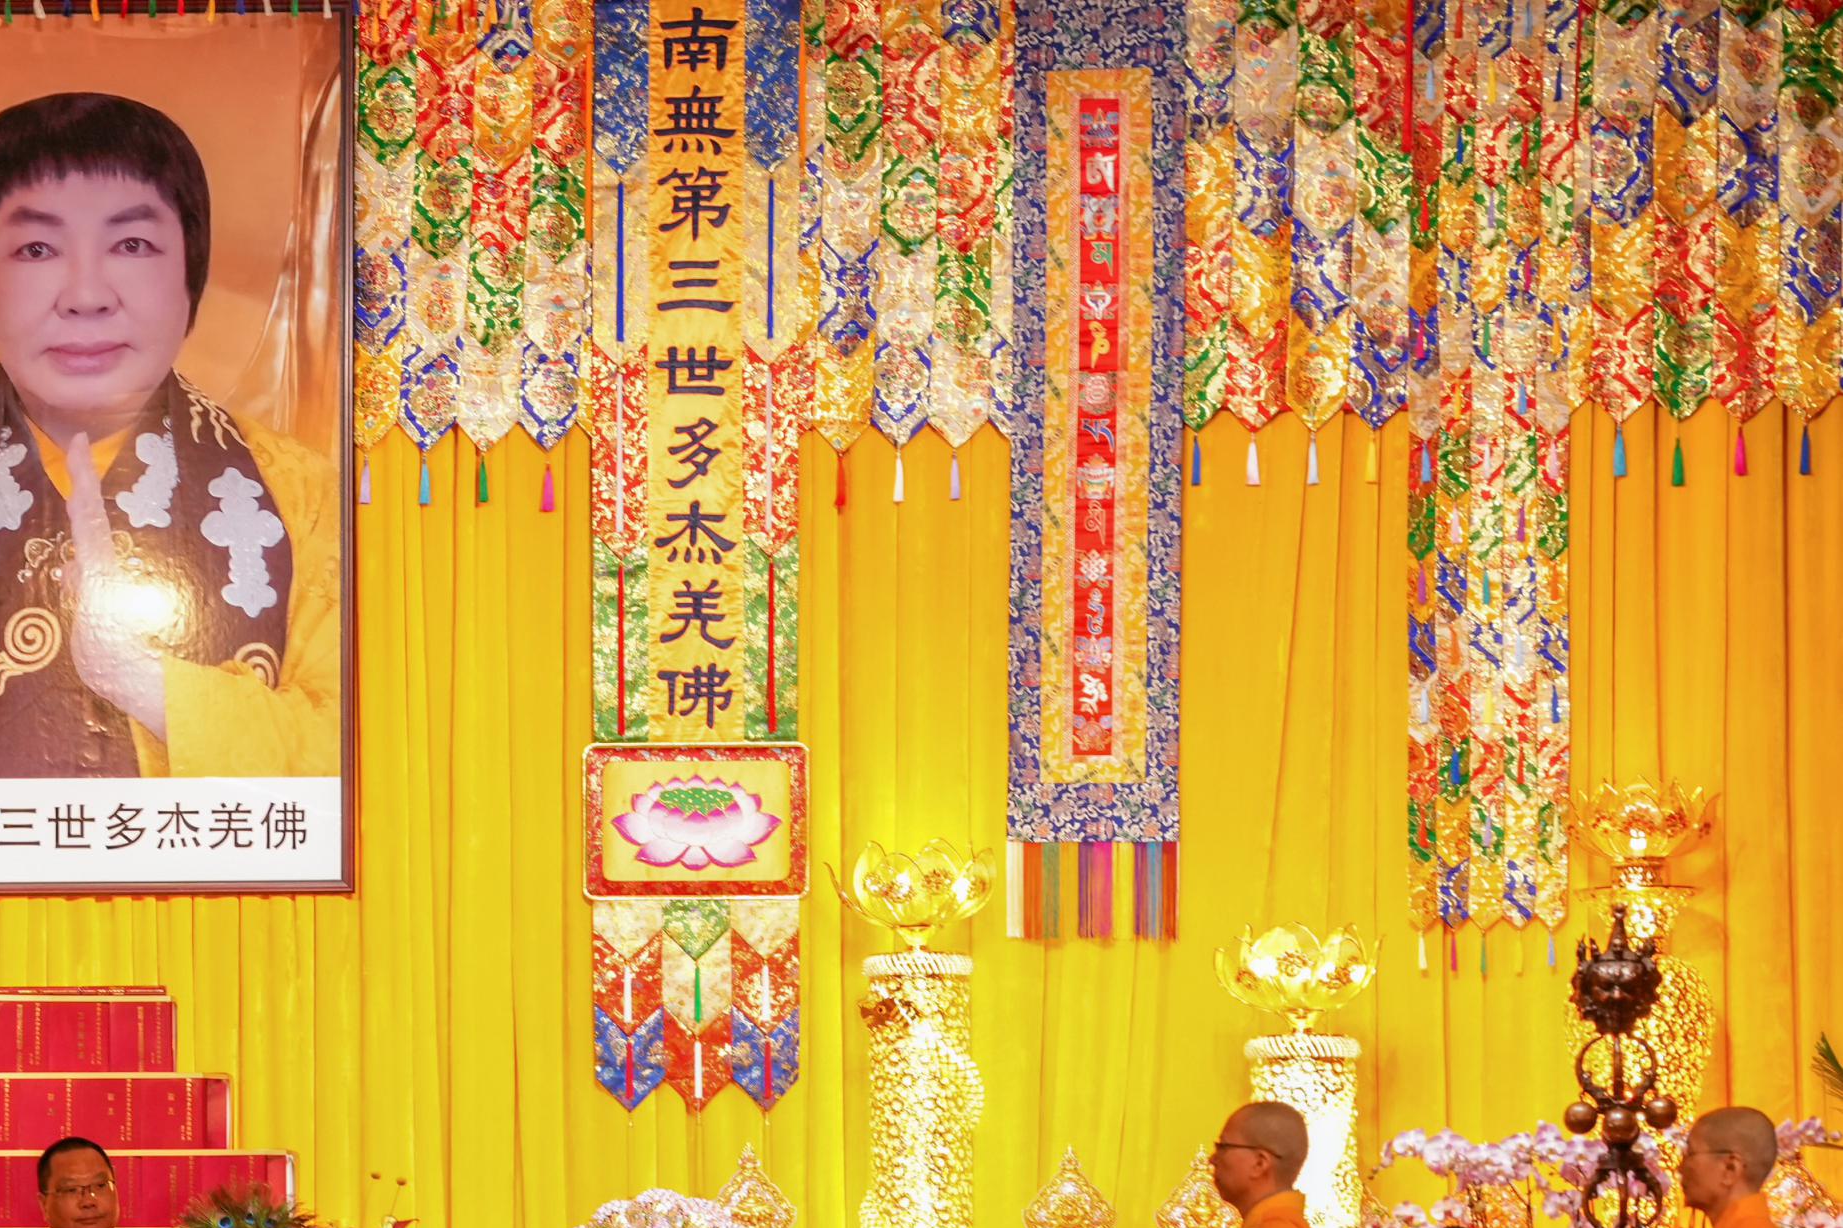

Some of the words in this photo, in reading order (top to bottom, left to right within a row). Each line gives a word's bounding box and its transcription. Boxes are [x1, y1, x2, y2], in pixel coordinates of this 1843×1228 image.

[654, 7, 737, 729] 南無第三世多杰羌佛
